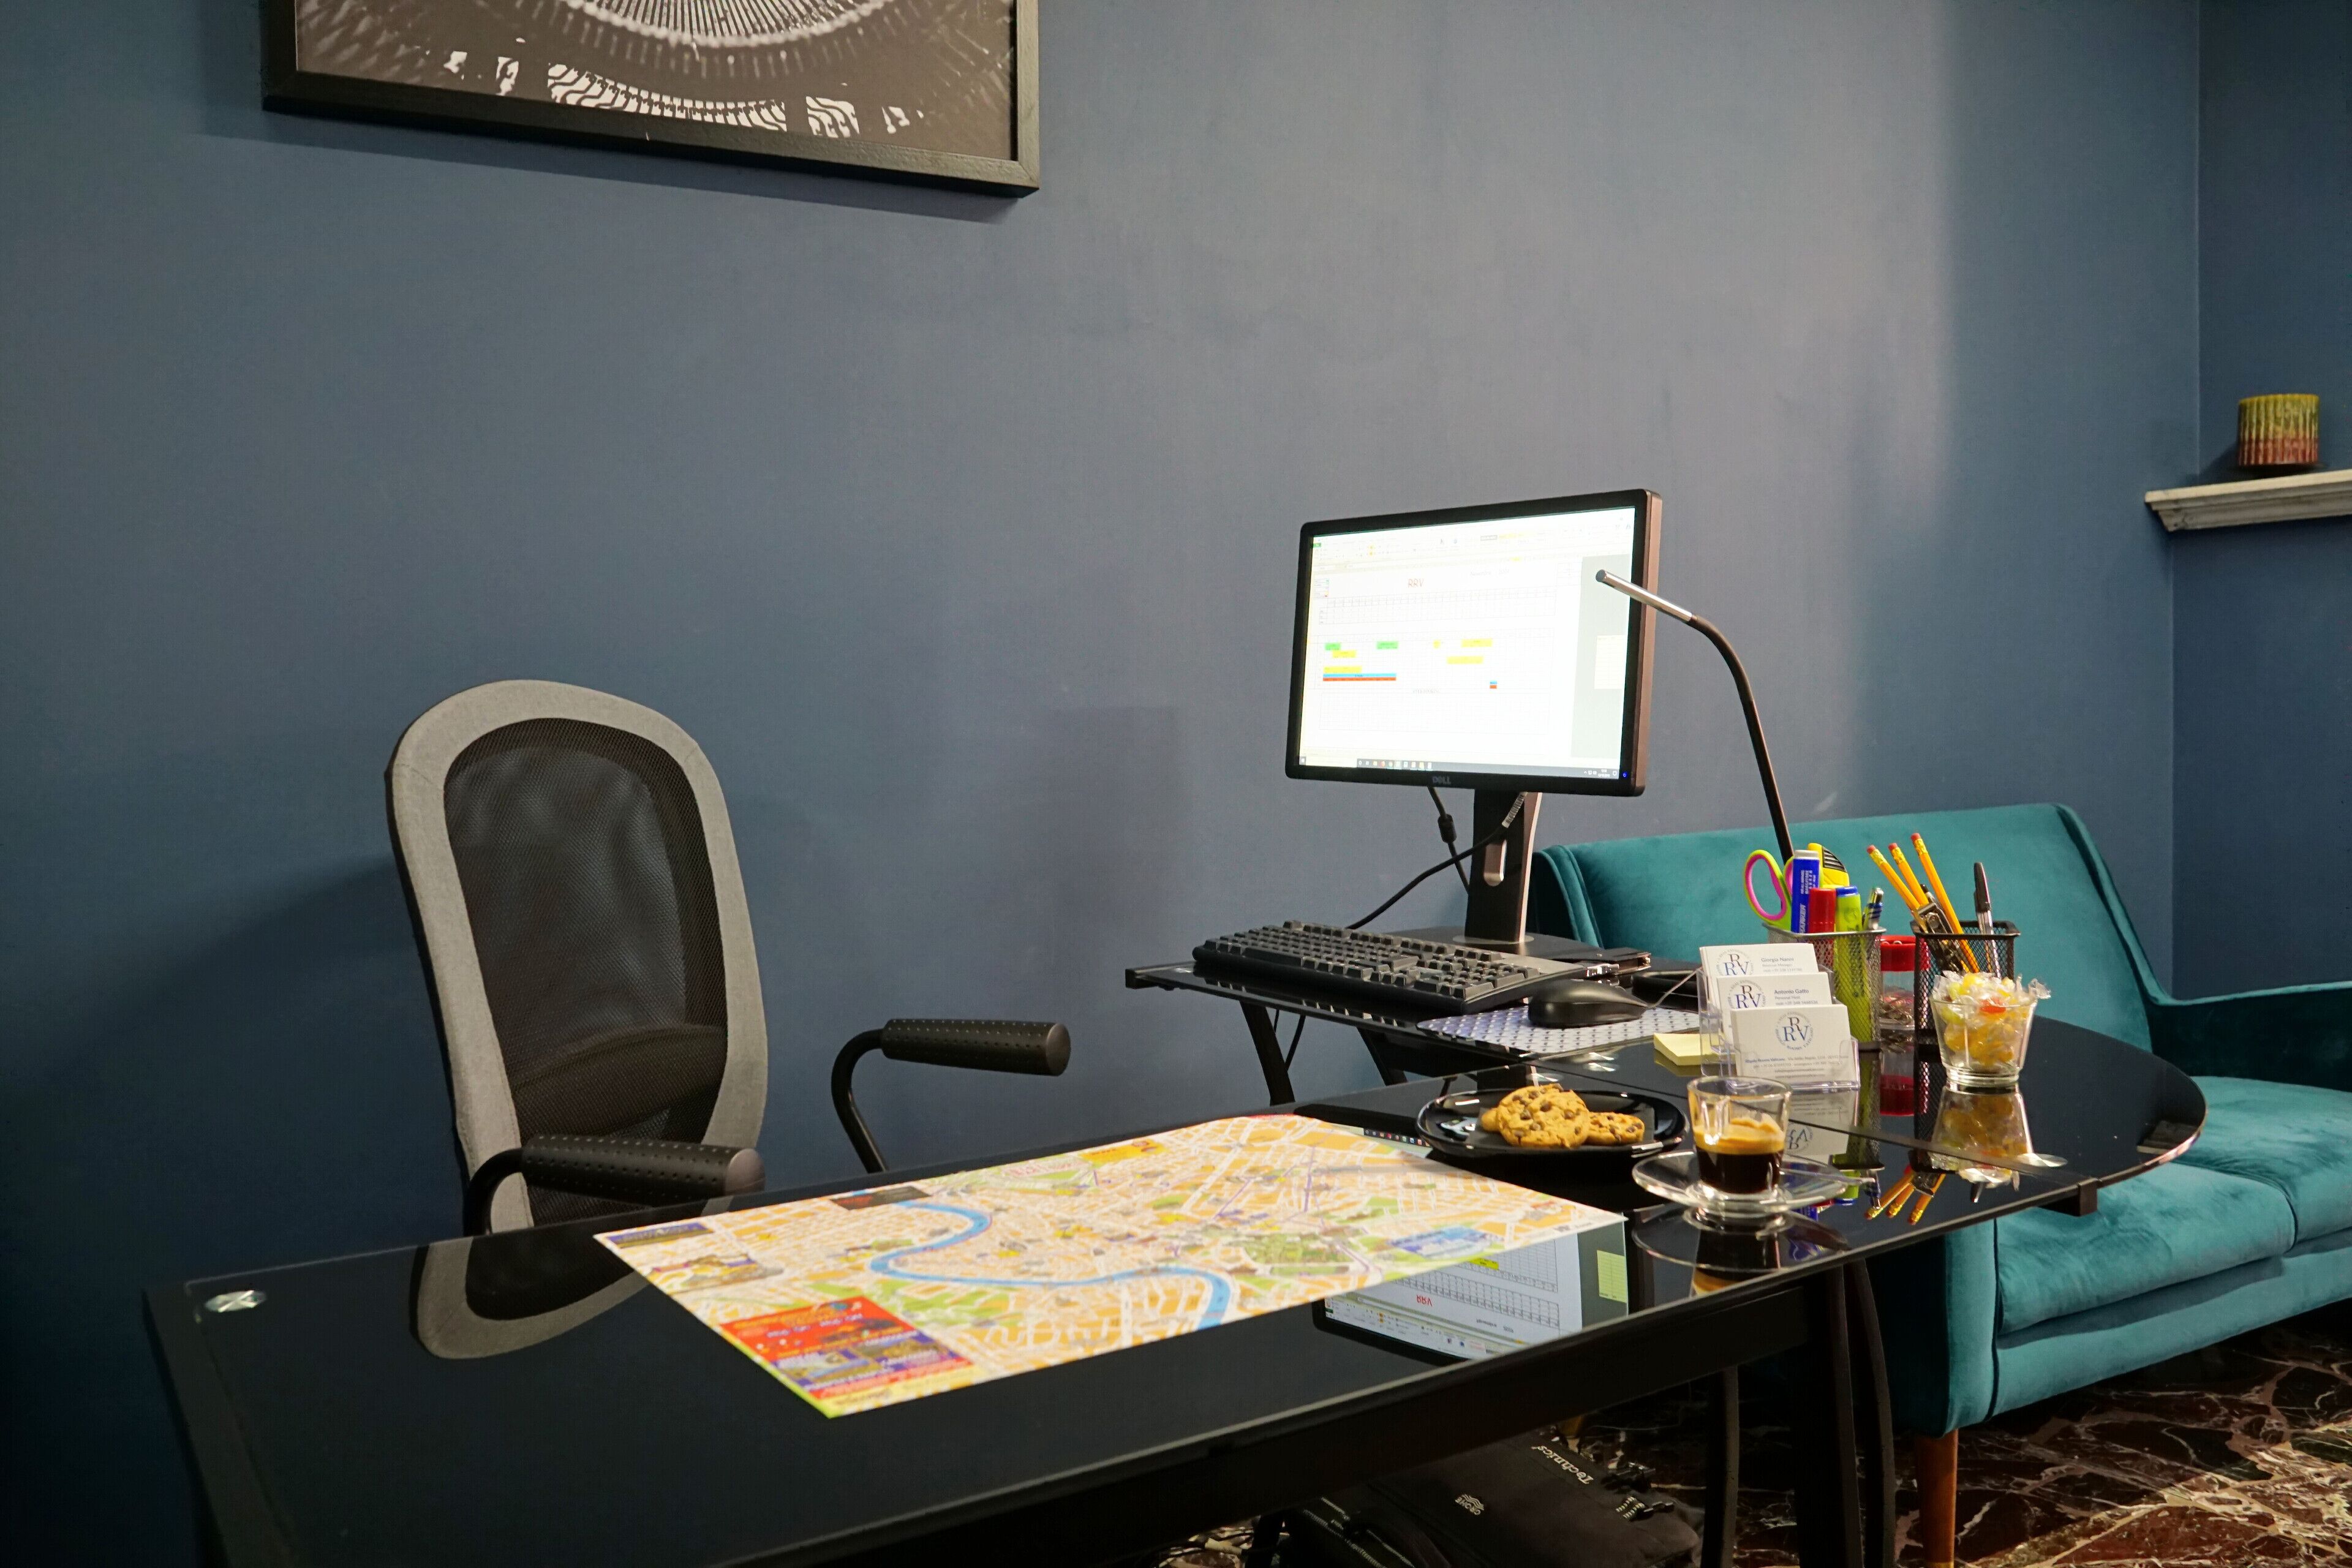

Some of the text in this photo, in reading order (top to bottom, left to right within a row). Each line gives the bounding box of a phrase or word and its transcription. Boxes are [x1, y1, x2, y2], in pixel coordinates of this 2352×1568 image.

[1408, 578, 1424, 588] RRV
[1433, 776, 1451, 785] DELL
[1536, 1445, 1594, 1485] Technics
